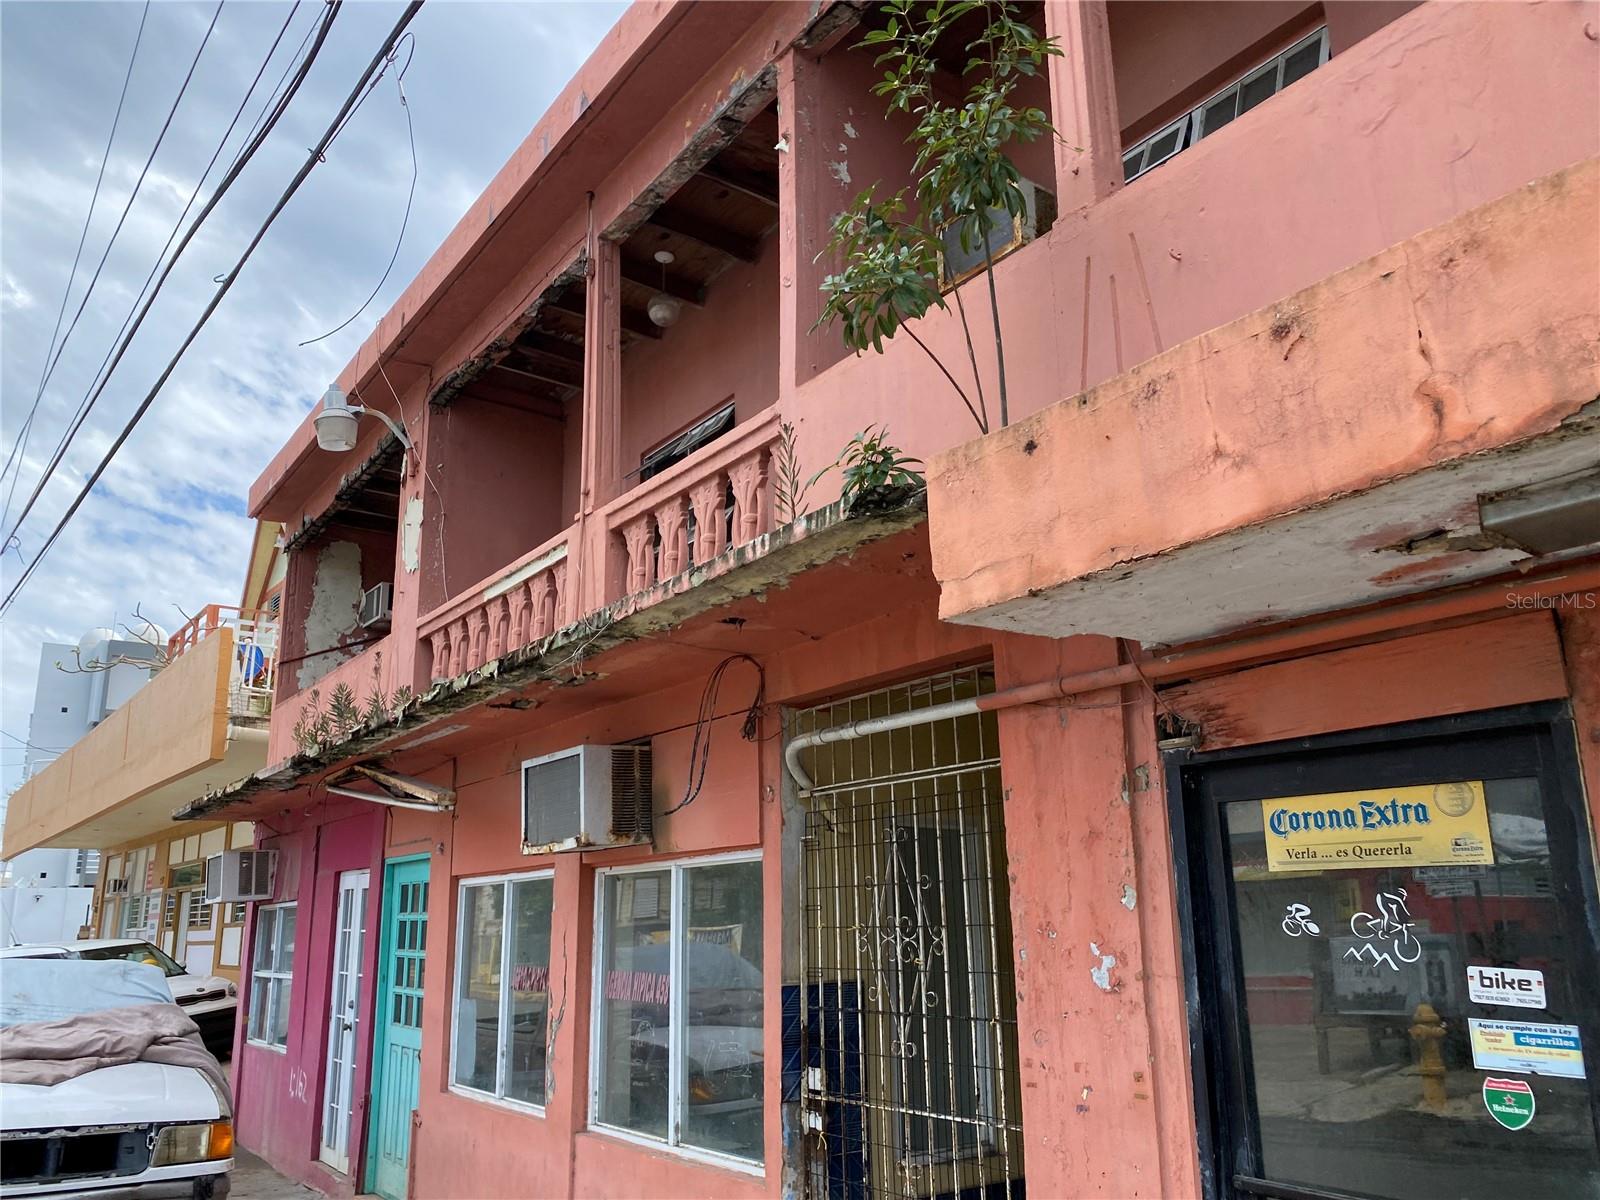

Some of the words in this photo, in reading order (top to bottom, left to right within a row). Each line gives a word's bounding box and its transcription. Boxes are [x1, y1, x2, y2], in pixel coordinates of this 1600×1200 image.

[1269, 808, 1357, 840] Corona
[1359, 798, 1432, 831] Extra
[1286, 848, 1317, 860] Verla
[1336, 848, 1349, 858] es
[1352, 843, 1413, 859] Quererla
[1478, 970, 1533, 991] bike
[1559, 1028, 1572, 1036] Ley
[1519, 1035, 1576, 1047] cigarrillos
[1492, 1104, 1529, 1115] Heineken
